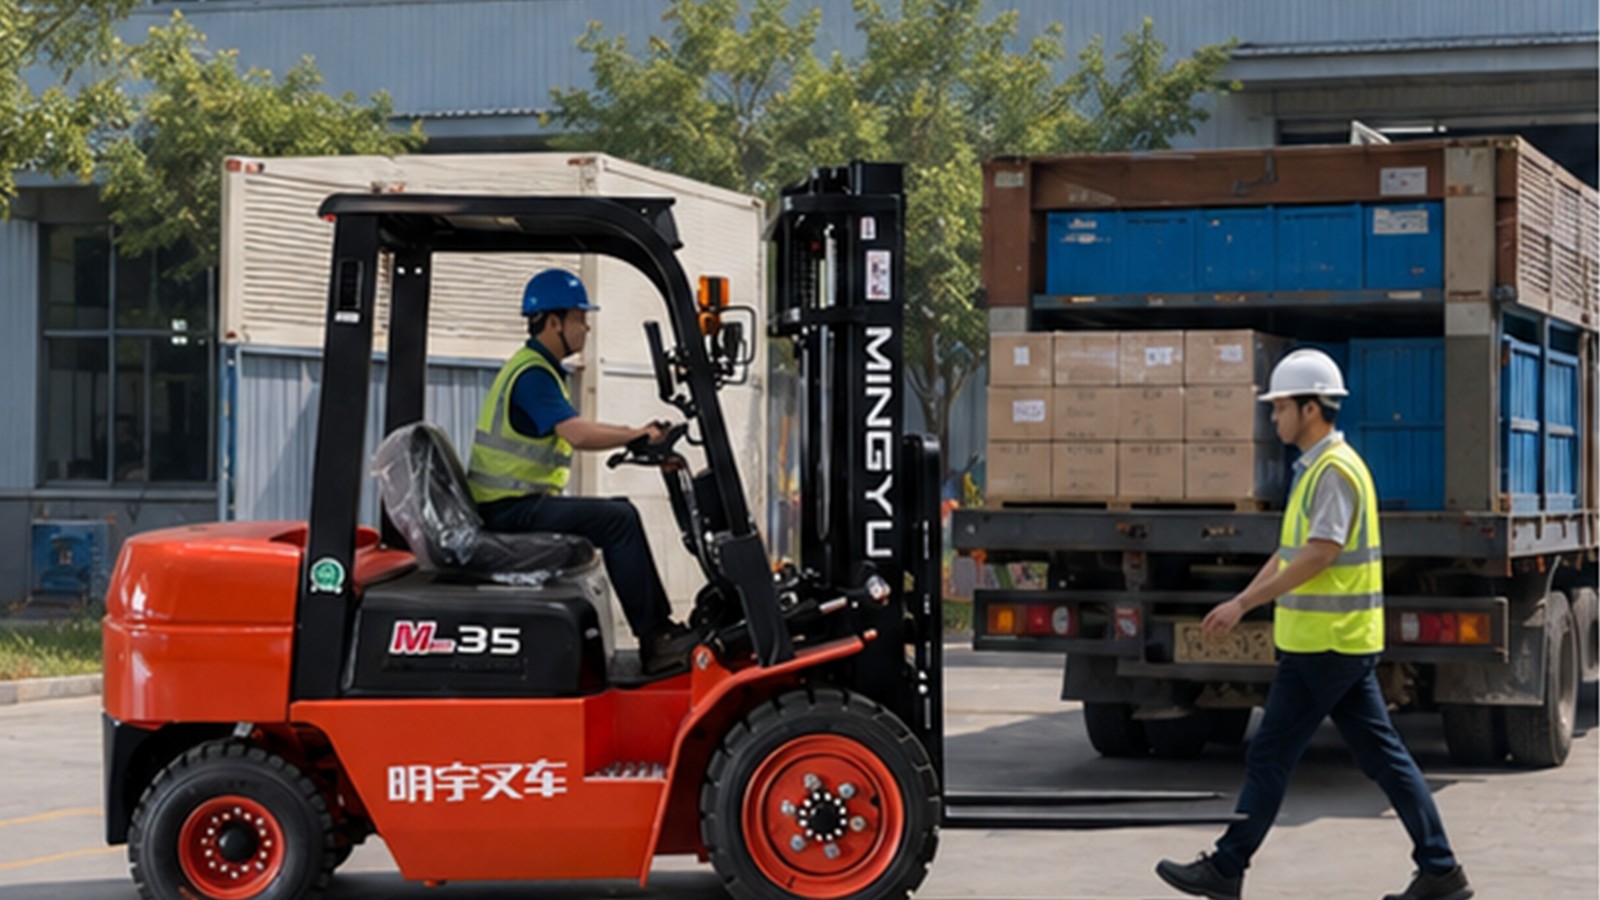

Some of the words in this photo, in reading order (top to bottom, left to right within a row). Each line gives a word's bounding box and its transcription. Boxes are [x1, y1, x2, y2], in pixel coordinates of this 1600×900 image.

[865, 326, 893, 558] MINGYU
[387, 758, 568, 803] 明宇叉车
